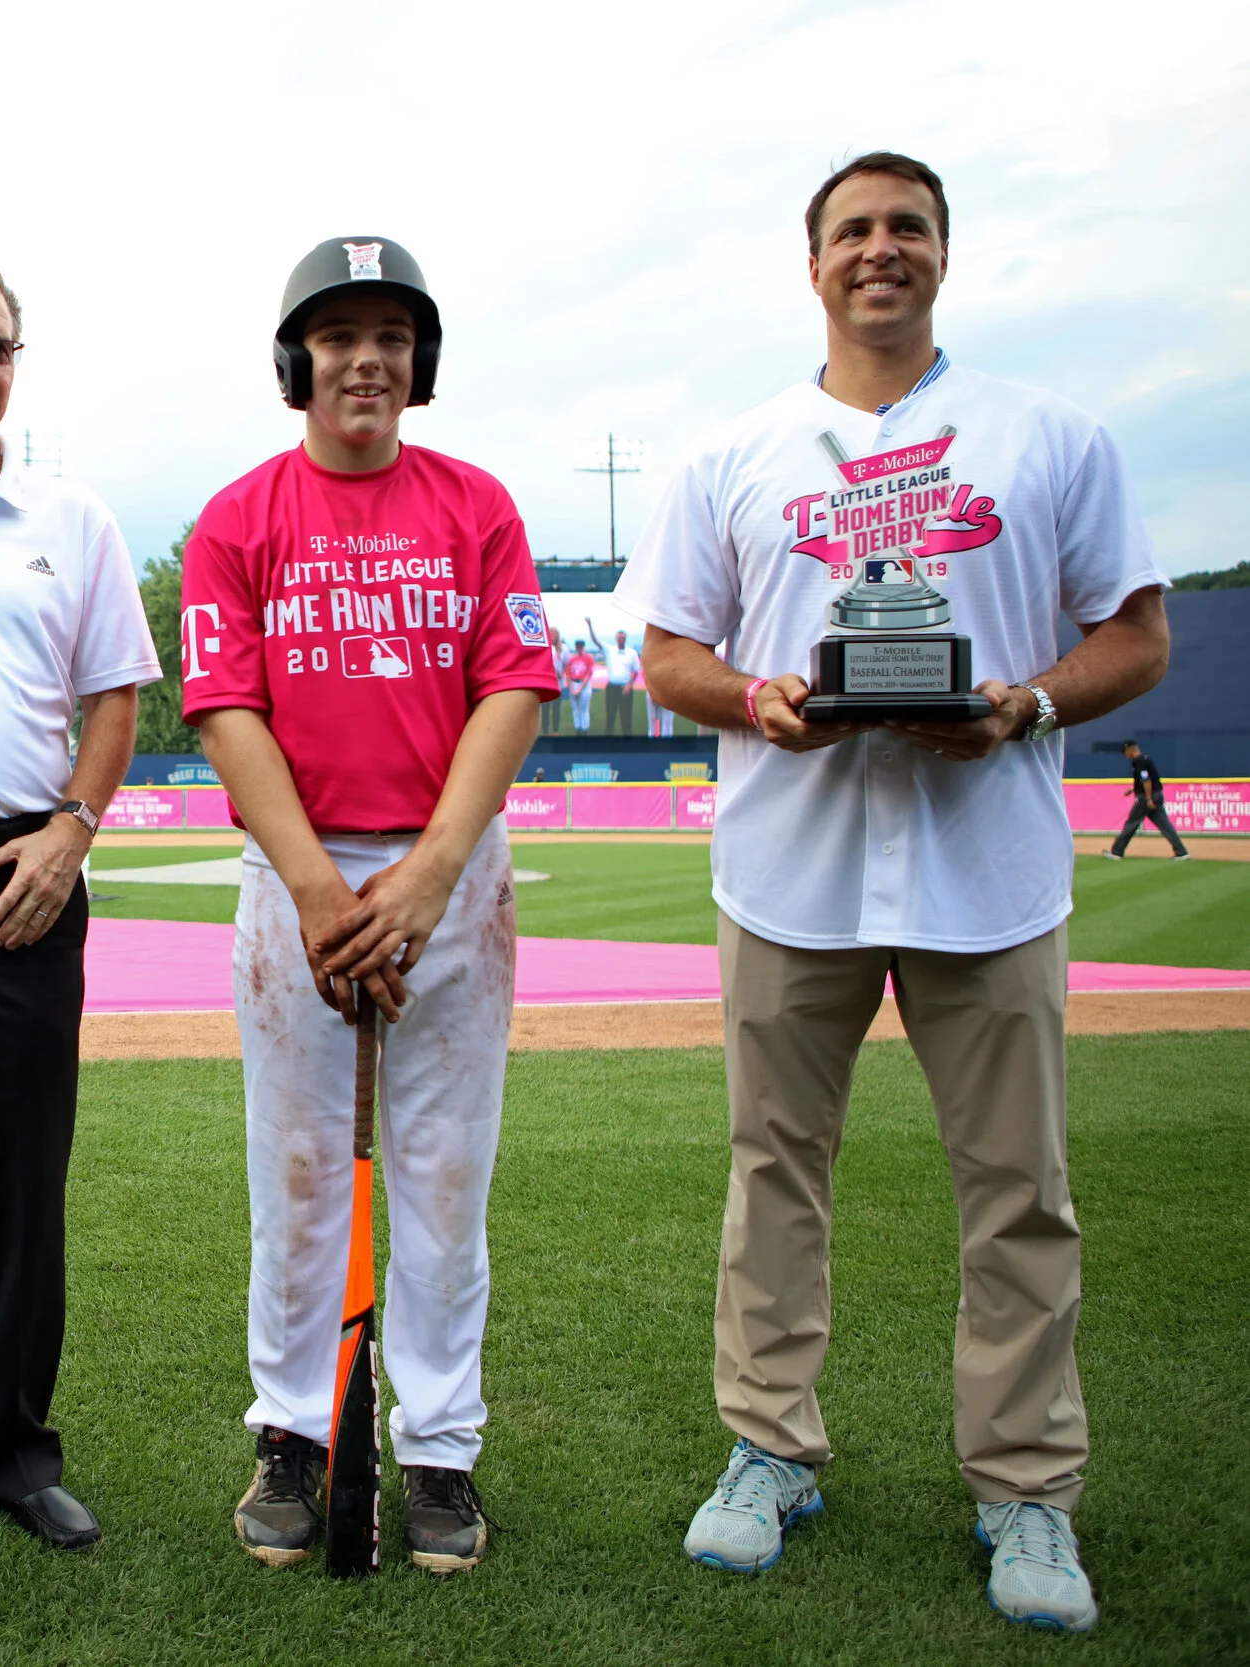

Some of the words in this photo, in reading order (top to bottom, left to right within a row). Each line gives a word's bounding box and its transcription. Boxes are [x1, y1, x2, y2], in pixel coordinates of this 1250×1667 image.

[831, 485, 883, 509] LITTLE
[888, 467, 950, 494] LEAGUE
[835, 499, 896, 536] HOME
[900, 487, 947, 519] RUN
[854, 518, 925, 559] DERBY
[26, 563, 55, 577] adidas
[284, 560, 356, 587] LITTLE
[361, 557, 454, 585] LEAGUE
[831, 564, 853, 580] 20
[926, 562, 947, 577] 19
[264, 594, 323, 638] OME
[329, 587, 396, 633] RUN
[287, 647, 329, 675] 20
[421, 643, 454, 668] 19
[850, 655, 868, 663] LITTLE
[870, 655, 890, 663] LEAGUE
[892, 655, 909, 663] HOME
[926, 654, 944, 662] DERBY
[873, 647, 921, 655] T-MOBILE
[850, 667, 891, 677] BASEBALL
[893, 666, 944, 677] CHAMPION
[1175, 791, 1205, 801] LITTLE
[1206, 791, 1241, 801] LEAGUE
[1164, 801, 1190, 816] OME
[1192, 800, 1218, 816] RUN
